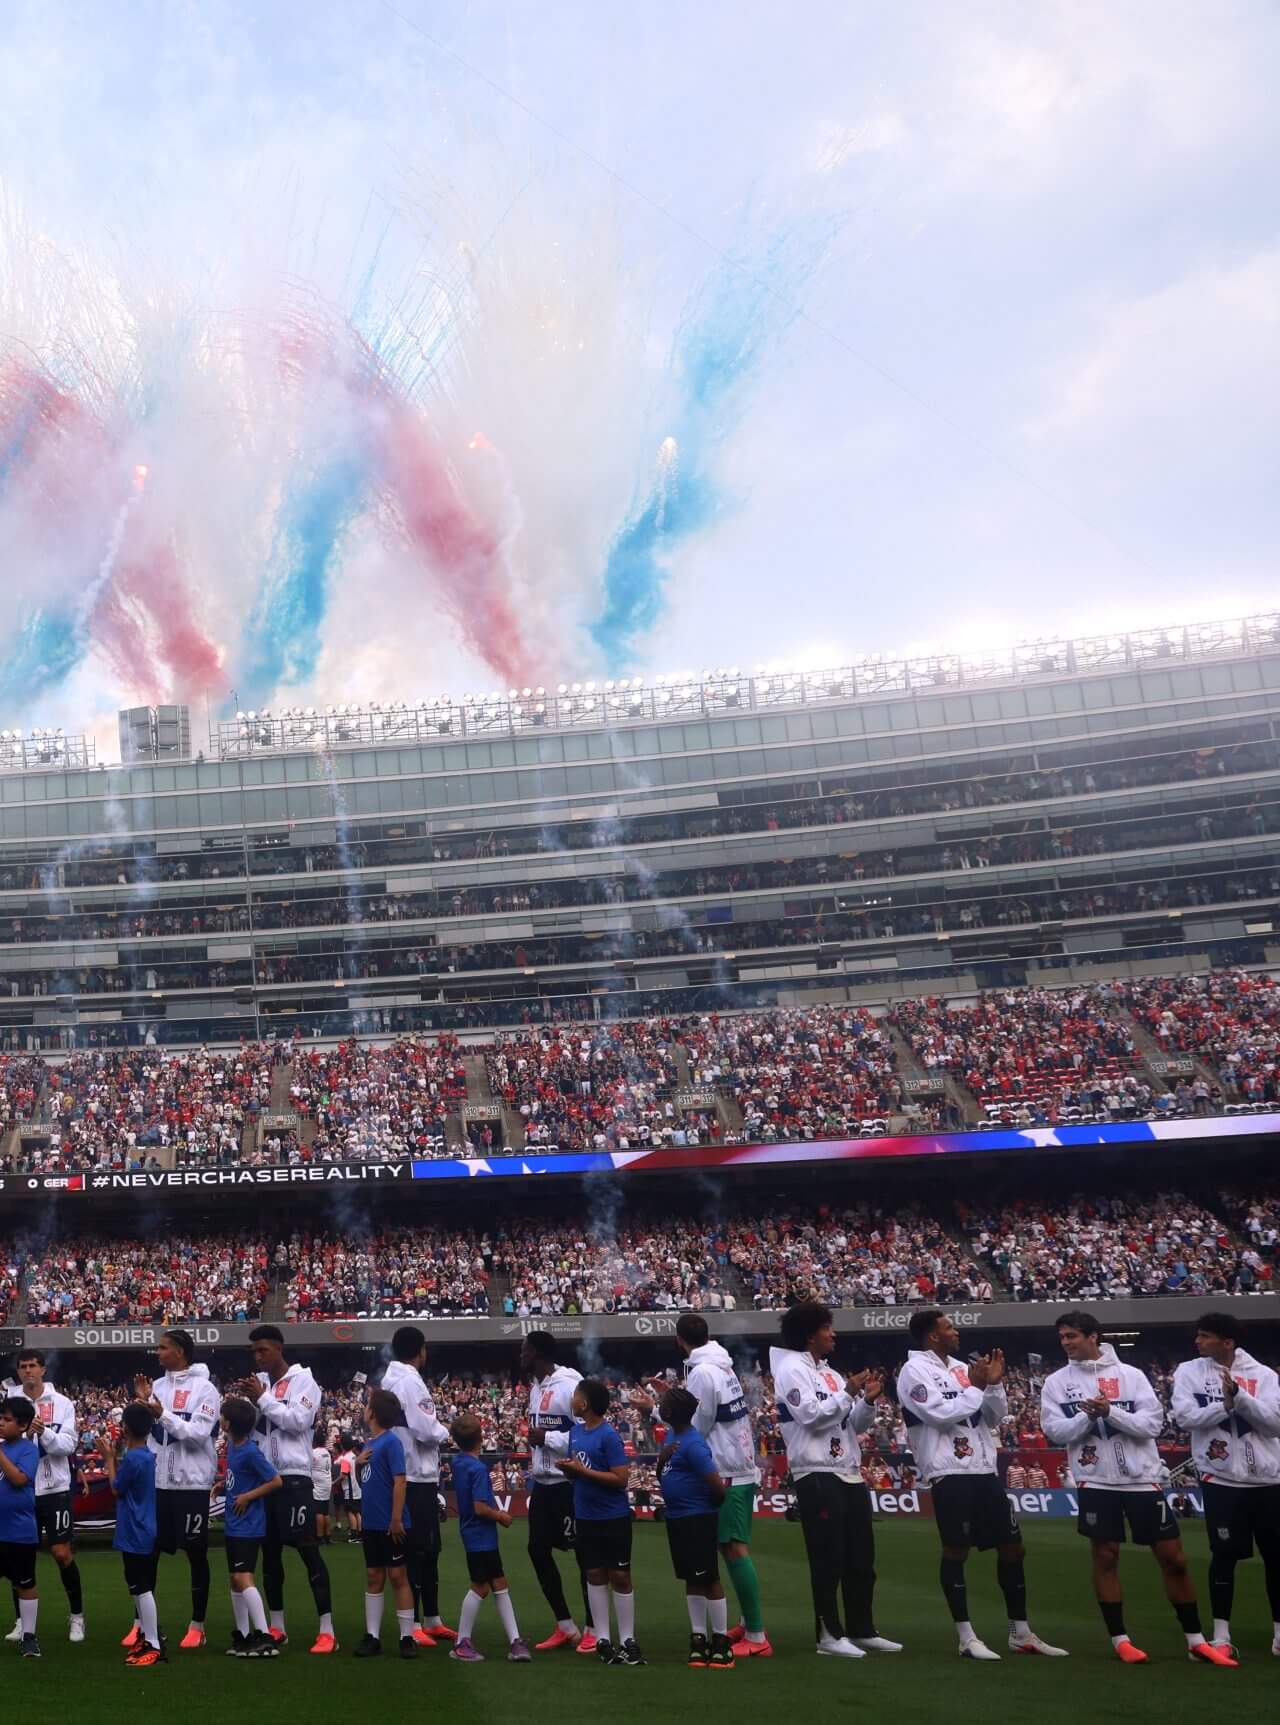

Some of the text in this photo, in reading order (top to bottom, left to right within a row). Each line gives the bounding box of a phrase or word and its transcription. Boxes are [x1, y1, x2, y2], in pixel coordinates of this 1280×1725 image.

[43, 1178, 69, 1188] GER
[91, 1164, 404, 1189] #NEVERCHASEREALITY
[74, 1329, 155, 1345] SOLDIER
[55, 1510, 70, 1530] 10
[290, 1505, 307, 1527] 16
[1156, 1500, 1166, 1524] 7
[186, 1513, 203, 1534] 12
